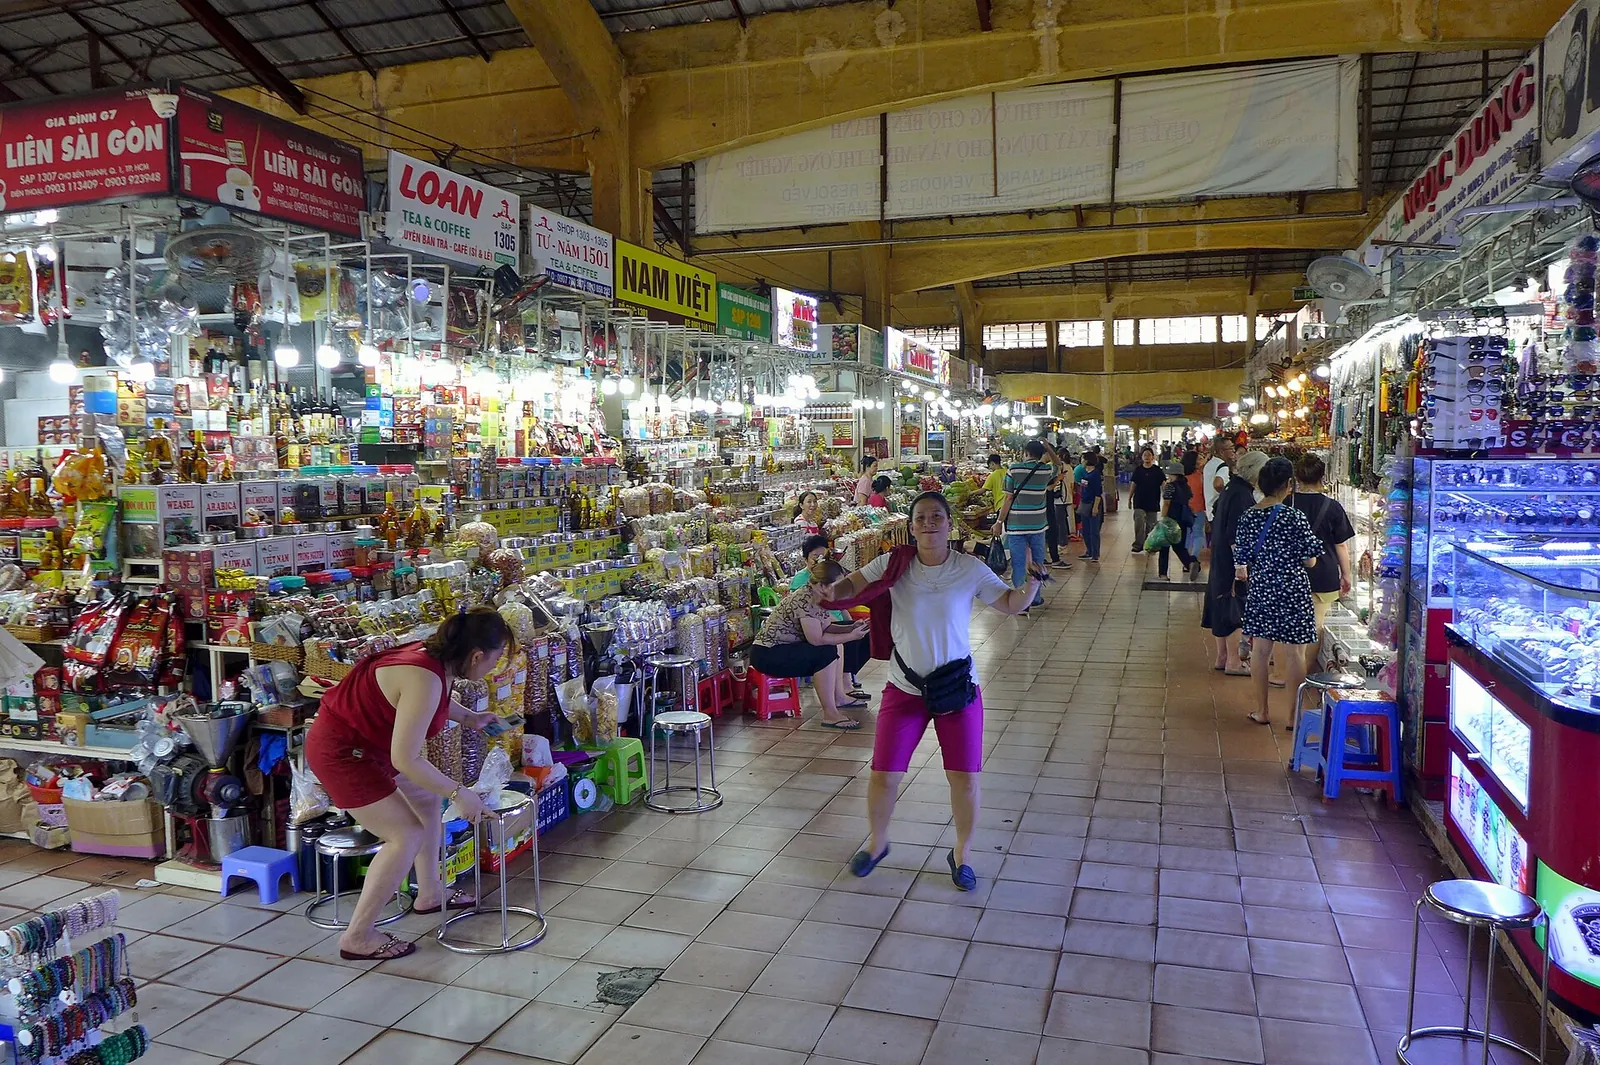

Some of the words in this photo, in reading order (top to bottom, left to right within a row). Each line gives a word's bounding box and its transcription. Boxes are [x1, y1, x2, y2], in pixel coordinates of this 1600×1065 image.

[45, 117, 66, 128] GIA
[100, 109, 118, 121] G7
[5, 133, 54, 169] LIÊN
[61, 127, 99, 162] SÀI
[107, 120, 164, 156] GÒN
[287, 139, 304, 153] GIA
[329, 152, 342, 165] G7
[37, 171, 57, 183] 1307
[44, 183, 65, 194] 0903
[68, 180, 98, 192] 113409
[104, 176, 126, 188] 0903
[128, 172, 161, 185] 923948
[264, 149, 298, 180] LIÊN
[303, 161, 327, 188] SÀI
[331, 170, 364, 199] GÒN
[399, 163, 484, 219] LOAN
[1403, 150, 1452, 226] NGỌC
[402, 210, 422, 227] TEA
[424, 216, 432, 229] &
[434, 218, 471, 239] COFFEE
[556, 221, 575, 236] SHOP
[576, 229, 590, 242] 1303
[594, 235, 608, 249] 1305
[494, 230, 516, 252] 1305
[557, 238, 580, 260] NĂM
[582, 244, 610, 269] 1501
[550, 257, 565, 271] TEA
[566, 263, 572, 272] &
[572, 264, 599, 280] COFFEE
[622, 256, 669, 301] NAM
[675, 273, 711, 317] VIỆT
[167, 500, 195, 510] WEASEL
[206, 501, 237, 511] ARABICA
[223, 557, 252, 568] LUWAK
